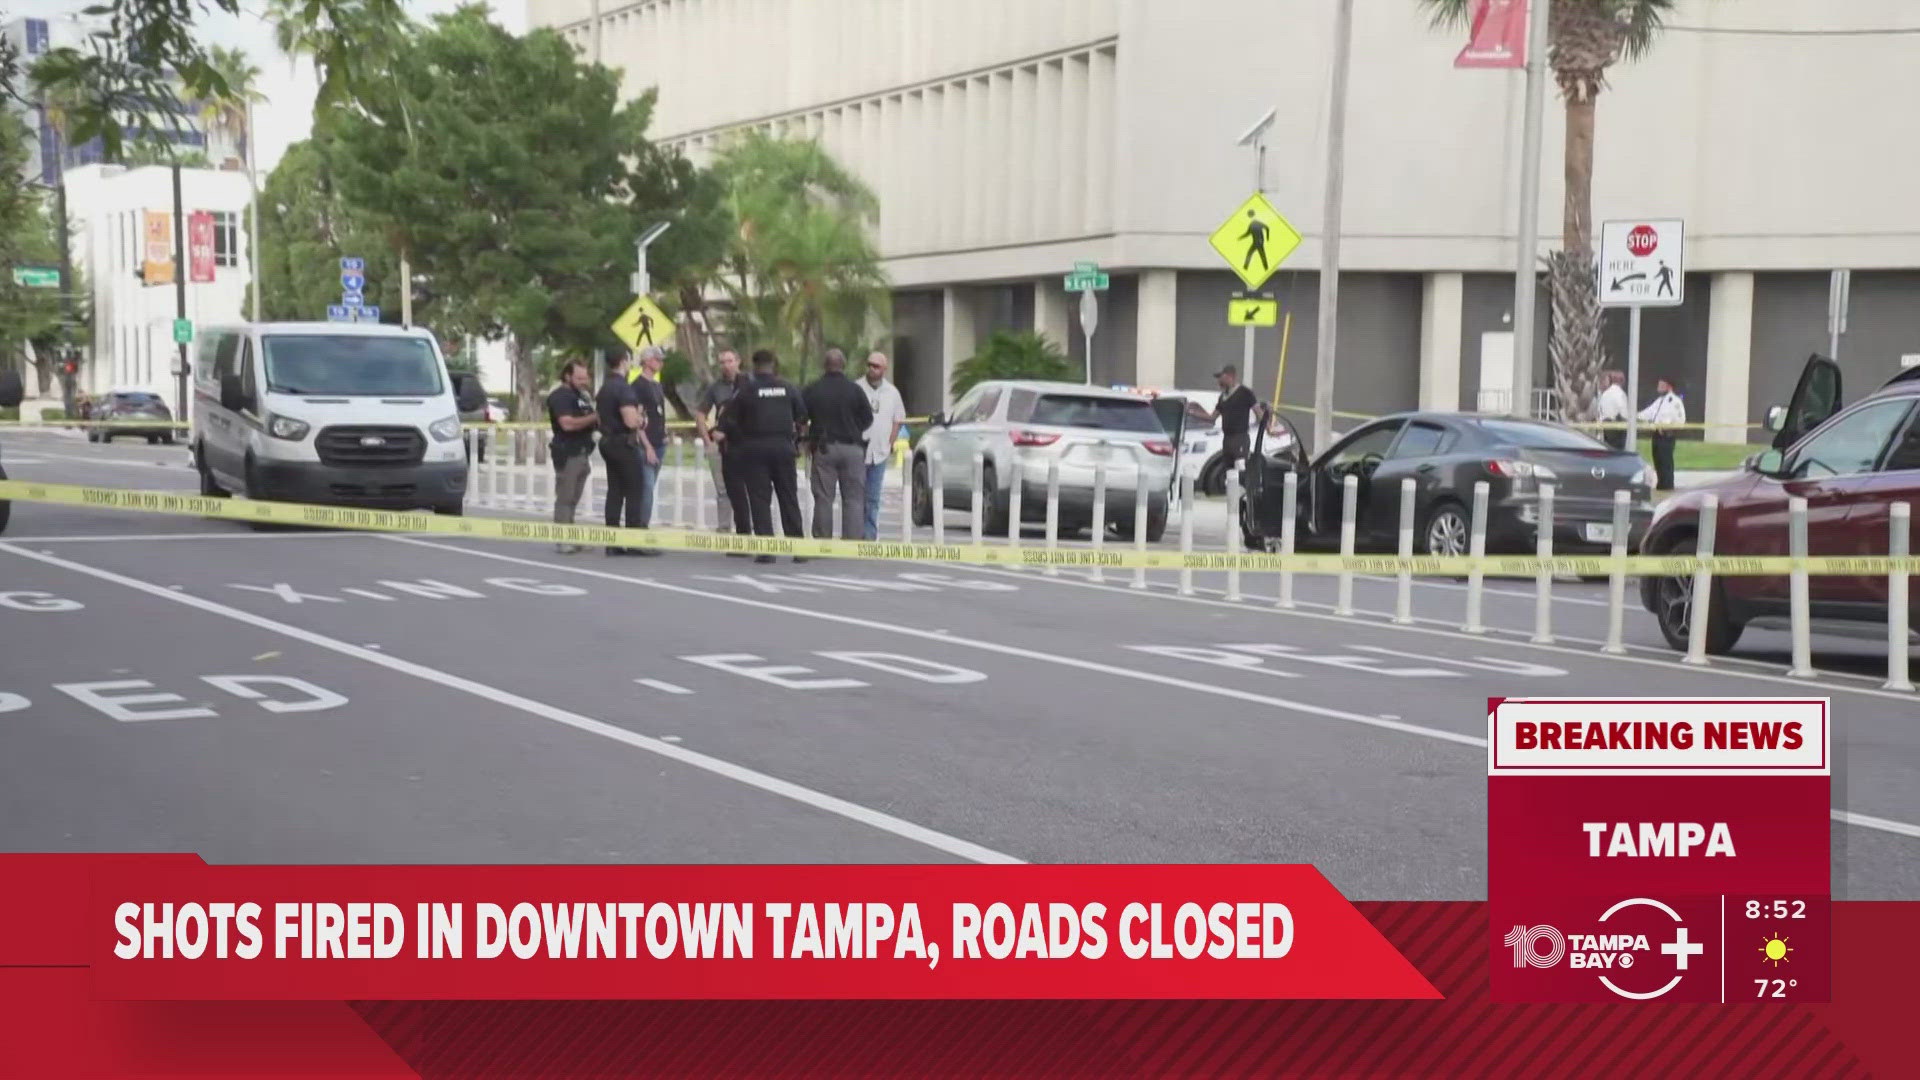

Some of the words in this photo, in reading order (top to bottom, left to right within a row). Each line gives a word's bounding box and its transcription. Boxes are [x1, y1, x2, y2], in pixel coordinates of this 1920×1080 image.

[1627, 233, 1657, 249] STOP
[1609, 260, 1633, 271] HERE
[1630, 283, 1650, 293] FOR
[397, 514, 427, 530] POLICE
[767, 539, 792, 552] POLICE
[857, 543, 883, 557] CROSS
[886, 545, 900, 558] NOT
[902, 545, 913, 558] DO
[916, 545, 932, 559] LINE
[935, 546, 960, 560] POLICE
[1023, 551, 1047, 562] CROSS
[1050, 551, 1064, 564] NOT
[1066, 552, 1076, 564] DO
[1080, 552, 1094, 565] LINE
[1097, 552, 1122, 566] POLICE
[222, 578, 588, 603] XING
